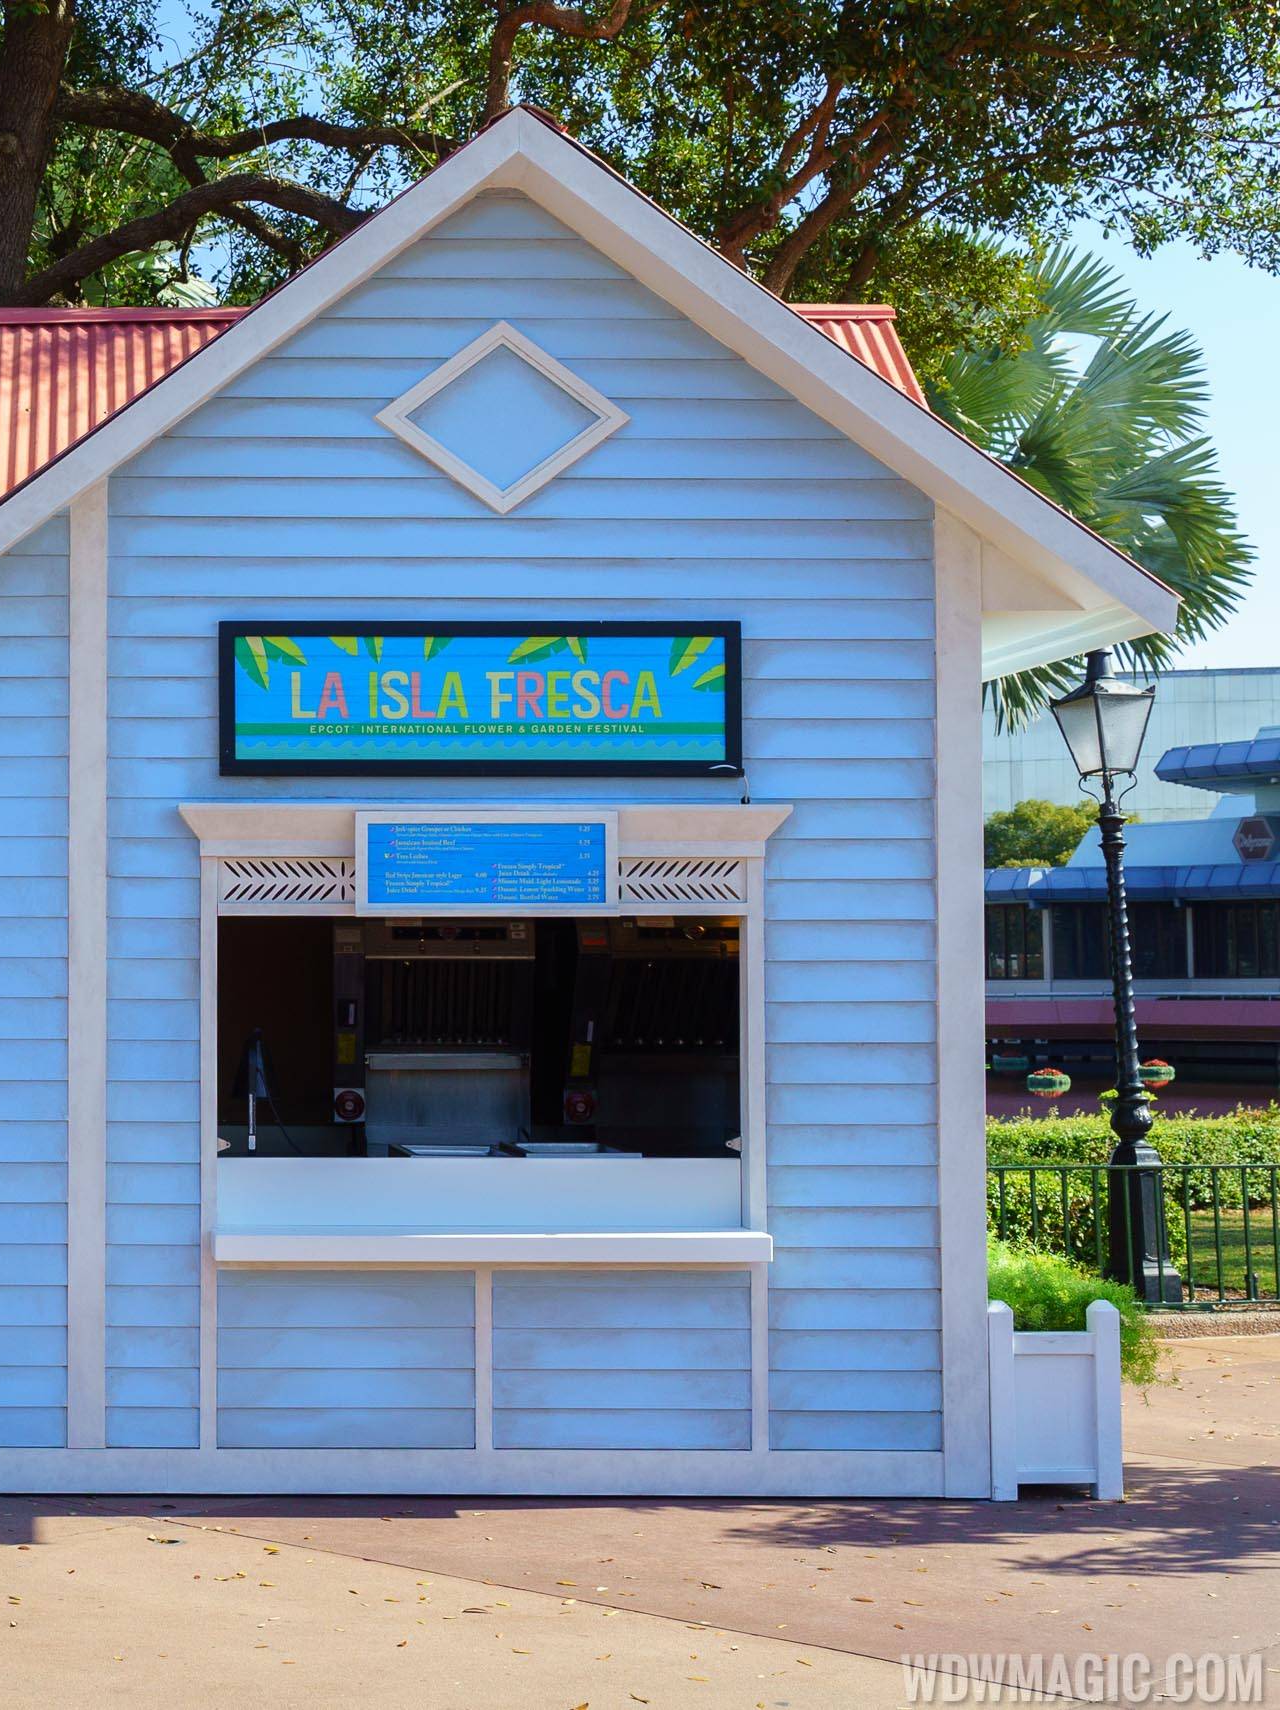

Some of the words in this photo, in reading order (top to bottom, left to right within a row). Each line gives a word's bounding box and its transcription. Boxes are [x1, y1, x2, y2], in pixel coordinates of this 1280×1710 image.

[290, 671, 349, 719] LA
[369, 670, 469, 719] ISLA
[485, 670, 663, 719] FRESCA
[309, 724, 351, 734] EPCOT
[361, 724, 458, 734] INTERNATIONAL
[464, 724, 513, 734] FLOWER
[519, 725, 526, 734] &
[531, 724, 582, 734] GARDEN
[587, 724, 645, 734] FESTIVAL
